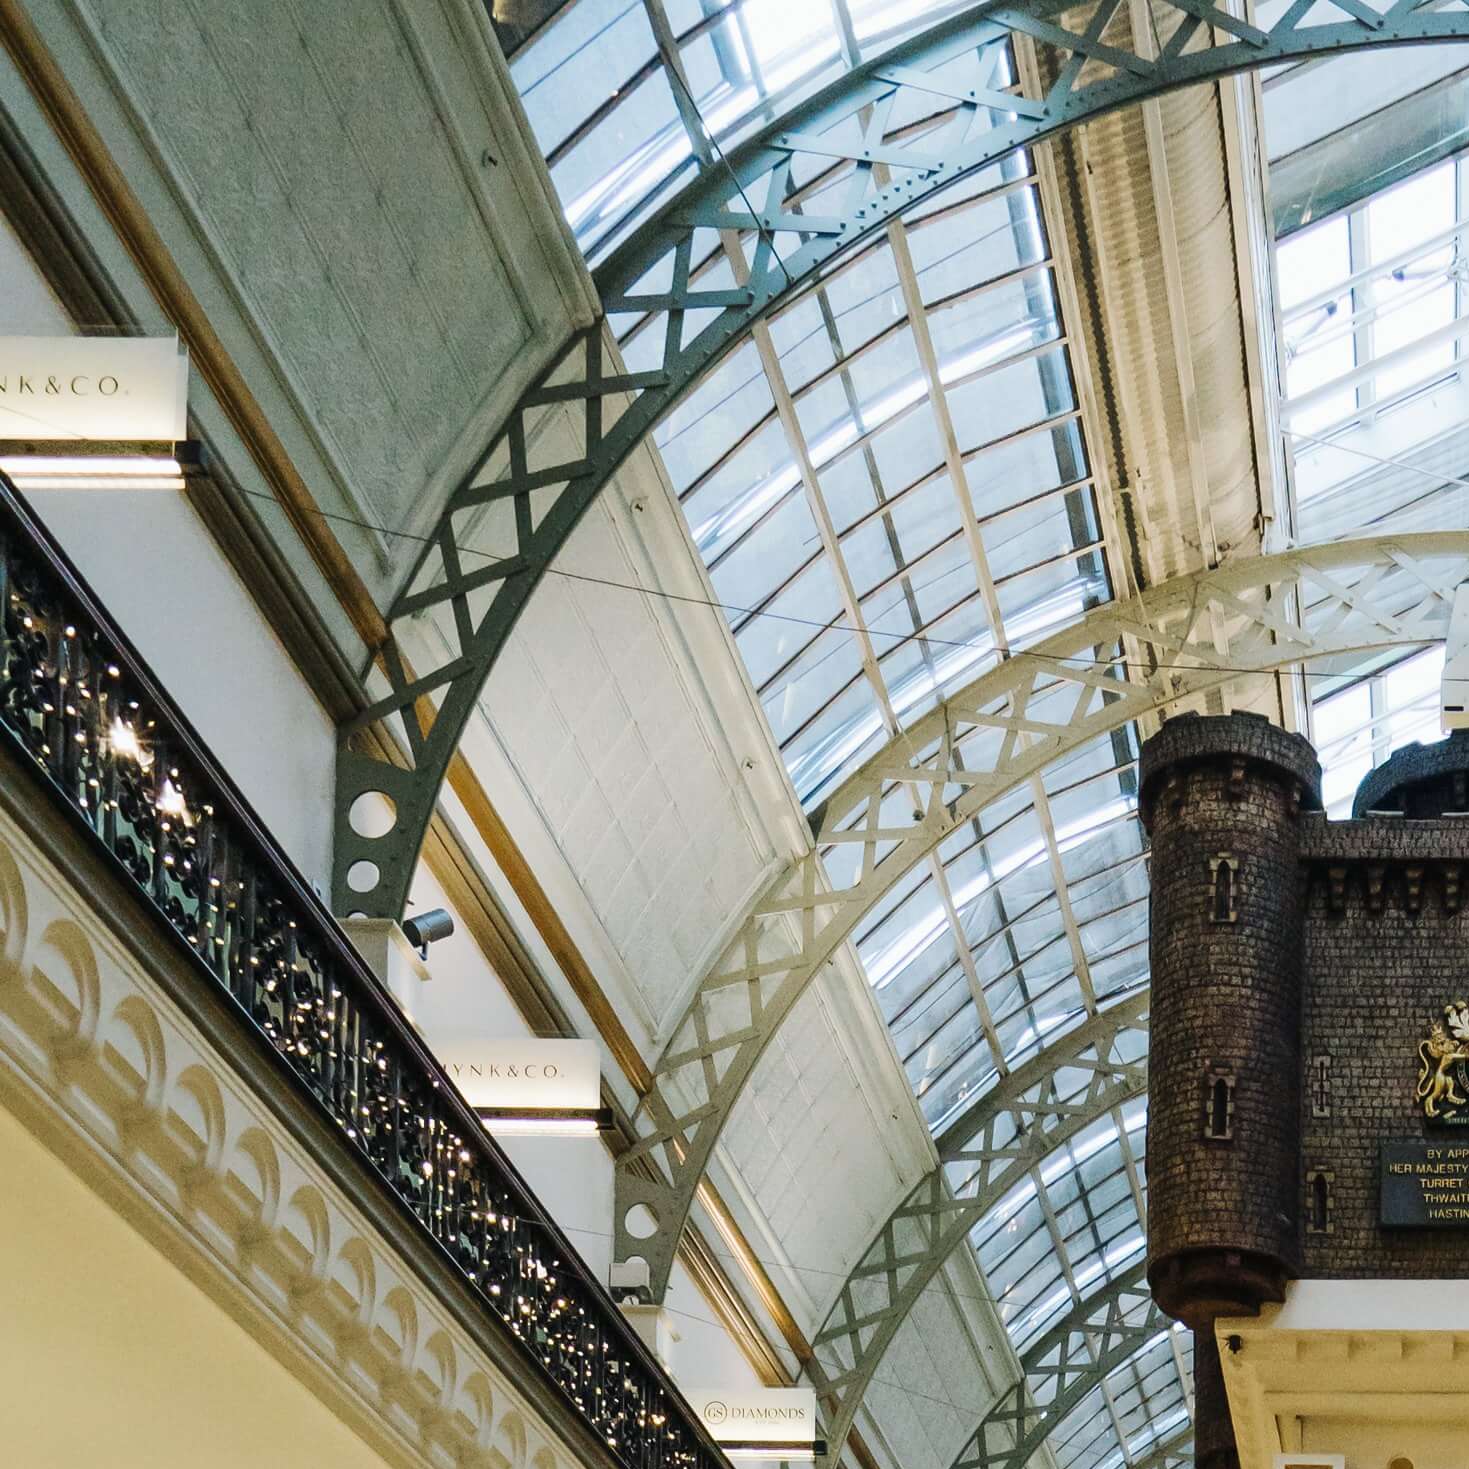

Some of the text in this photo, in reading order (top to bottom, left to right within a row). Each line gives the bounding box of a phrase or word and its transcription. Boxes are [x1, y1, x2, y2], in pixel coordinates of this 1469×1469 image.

[1427, 1149, 1442, 1159] BY
[1389, 1164, 1412, 1173] HER
[1416, 1164, 1469, 1174] MAJESTY
[1420, 1178, 1464, 1188] TURRET
[731, 1407, 805, 1419] DIAMONDS
